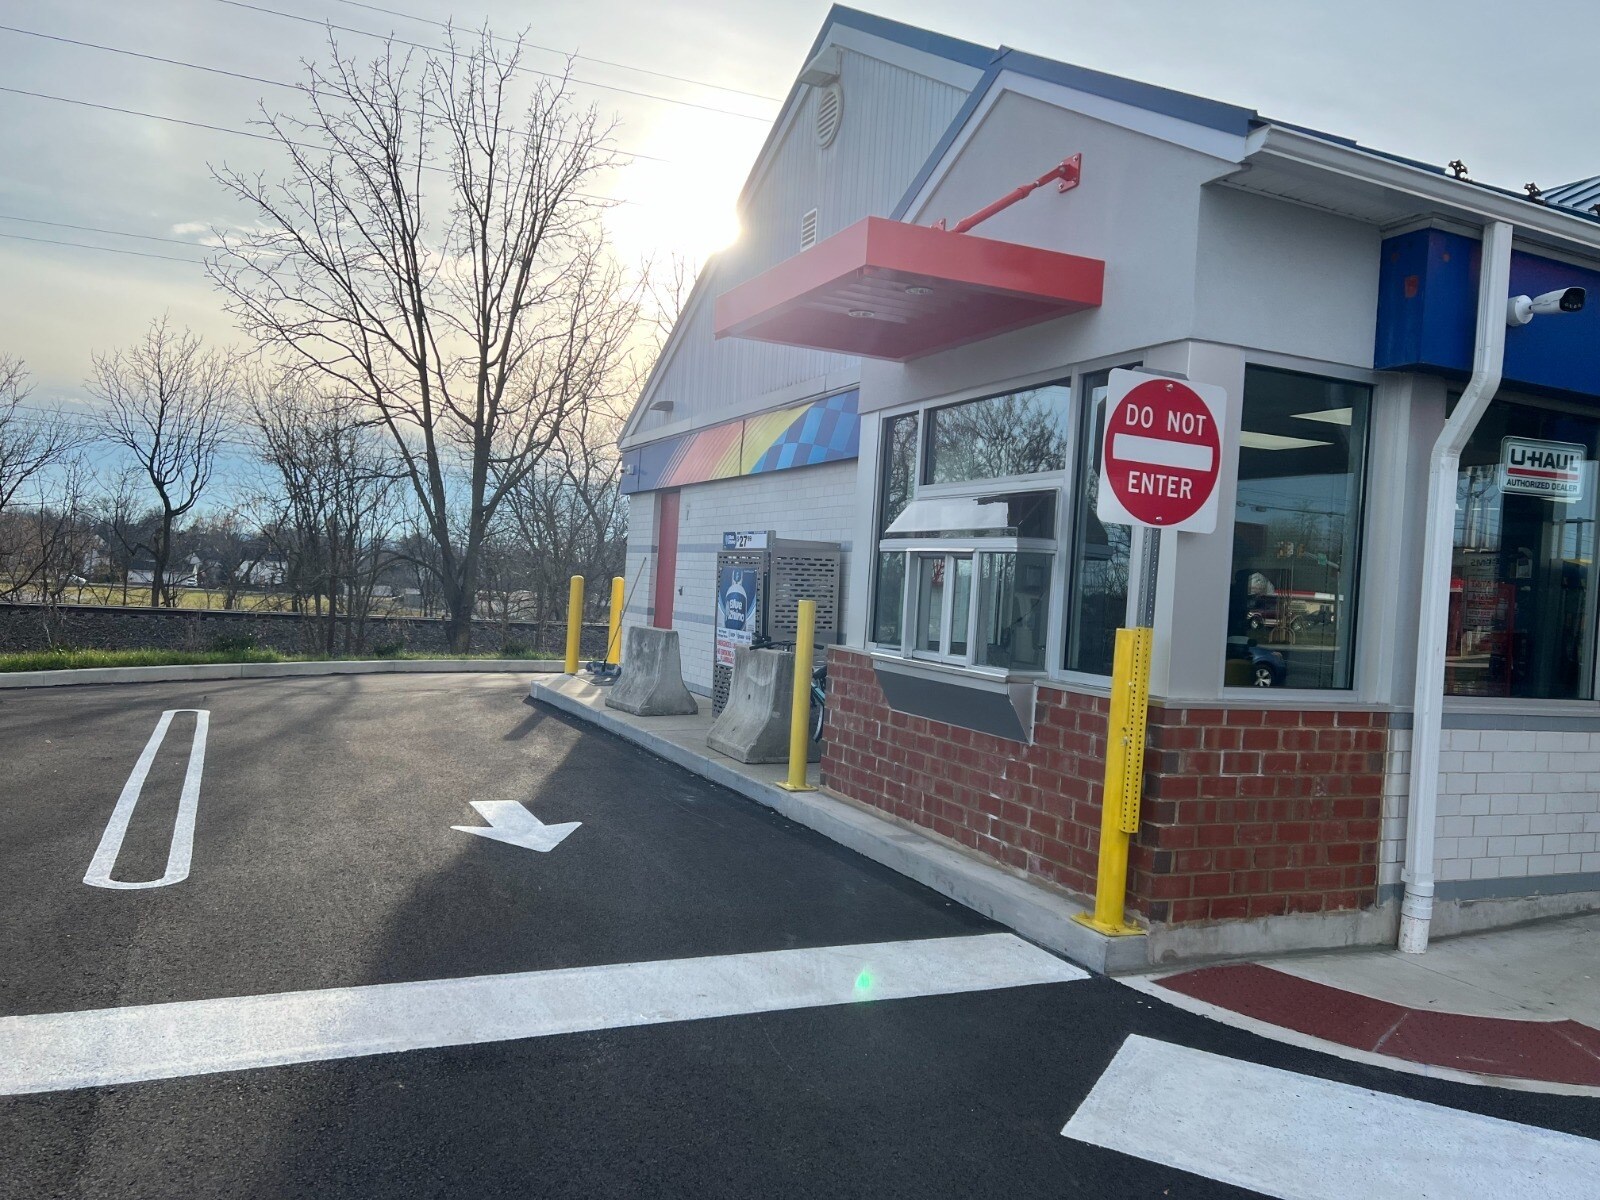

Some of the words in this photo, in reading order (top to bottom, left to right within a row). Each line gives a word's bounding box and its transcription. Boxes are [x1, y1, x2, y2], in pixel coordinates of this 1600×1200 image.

[1126, 403, 1154, 429] DO
[1167, 410, 1207, 436] NOT
[1510, 448, 1578, 472] U-HAUL
[1127, 471, 1193, 500] ENTER
[1506, 478, 1550, 490] AUTHORIZED
[1551, 483, 1577, 493] DEALER
[729, 598, 743, 610] Blue
